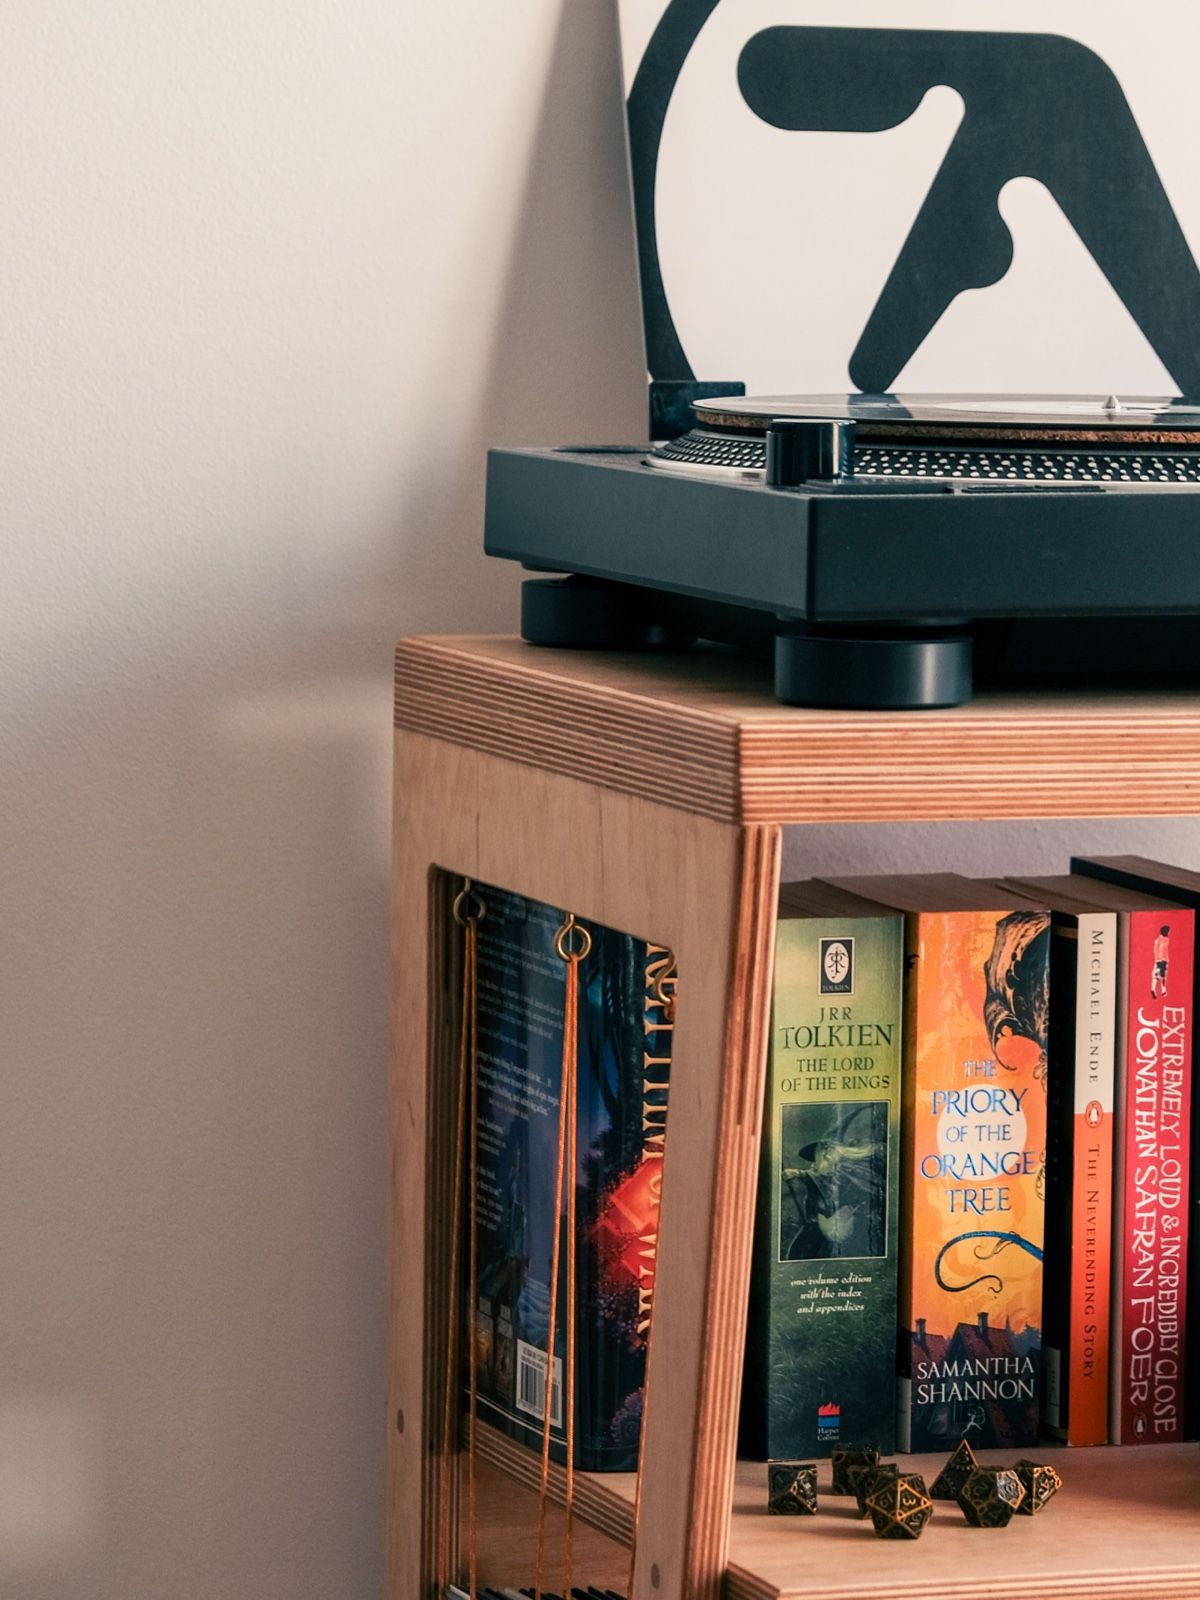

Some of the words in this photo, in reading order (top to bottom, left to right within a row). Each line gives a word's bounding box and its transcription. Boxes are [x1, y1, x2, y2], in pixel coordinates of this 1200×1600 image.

[1089, 930, 1104, 1019] MICHAEL
[779, 1024, 894, 1049] TOLKIEN
[796, 1058, 827, 1073] THE
[833, 1057, 874, 1072] LORD
[963, 1059, 997, 1077] THE
[1088, 1032, 1102, 1083] ENDE
[1160, 1006, 1185, 1138] EXTREMELY
[781, 1077, 801, 1092] OF
[805, 1076, 837, 1091] THE
[842, 1075, 890, 1089] RINGS
[1135, 1007, 1160, 1158] JONATHAN
[932, 1088, 1028, 1117] PRIORY
[946, 1126, 969, 1143] OF
[975, 1124, 1012, 1142] THE
[921, 1151, 1036, 1180] ORANGE
[1087, 1143, 1100, 1180] THE
[1158, 1145, 1182, 1209] LOUD
[945, 1187, 1012, 1215] TREE
[1132, 1167, 1158, 1288] SAFRAN
[1160, 1215, 1180, 1232] &
[1083, 1190, 1099, 1316] NEVERENDING
[790, 1279, 807, 1287] one
[808, 1274, 839, 1285] volume
[841, 1272, 872, 1284] edition
[800, 1288, 818, 1300] with
[821, 1287, 835, 1299] the
[837, 1286, 863, 1298] index
[797, 1302, 814, 1314] and
[816, 1300, 865, 1315] appendices
[1157, 1237, 1182, 1353] INCREDIBLY
[1083, 1325, 1098, 1380] STORY
[1129, 1296, 1155, 1406] FOER
[917, 1356, 1035, 1380] SAMANTHA
[917, 1379, 1034, 1405] SHANNON
[1153, 1360, 1178, 1433] CLOSE
